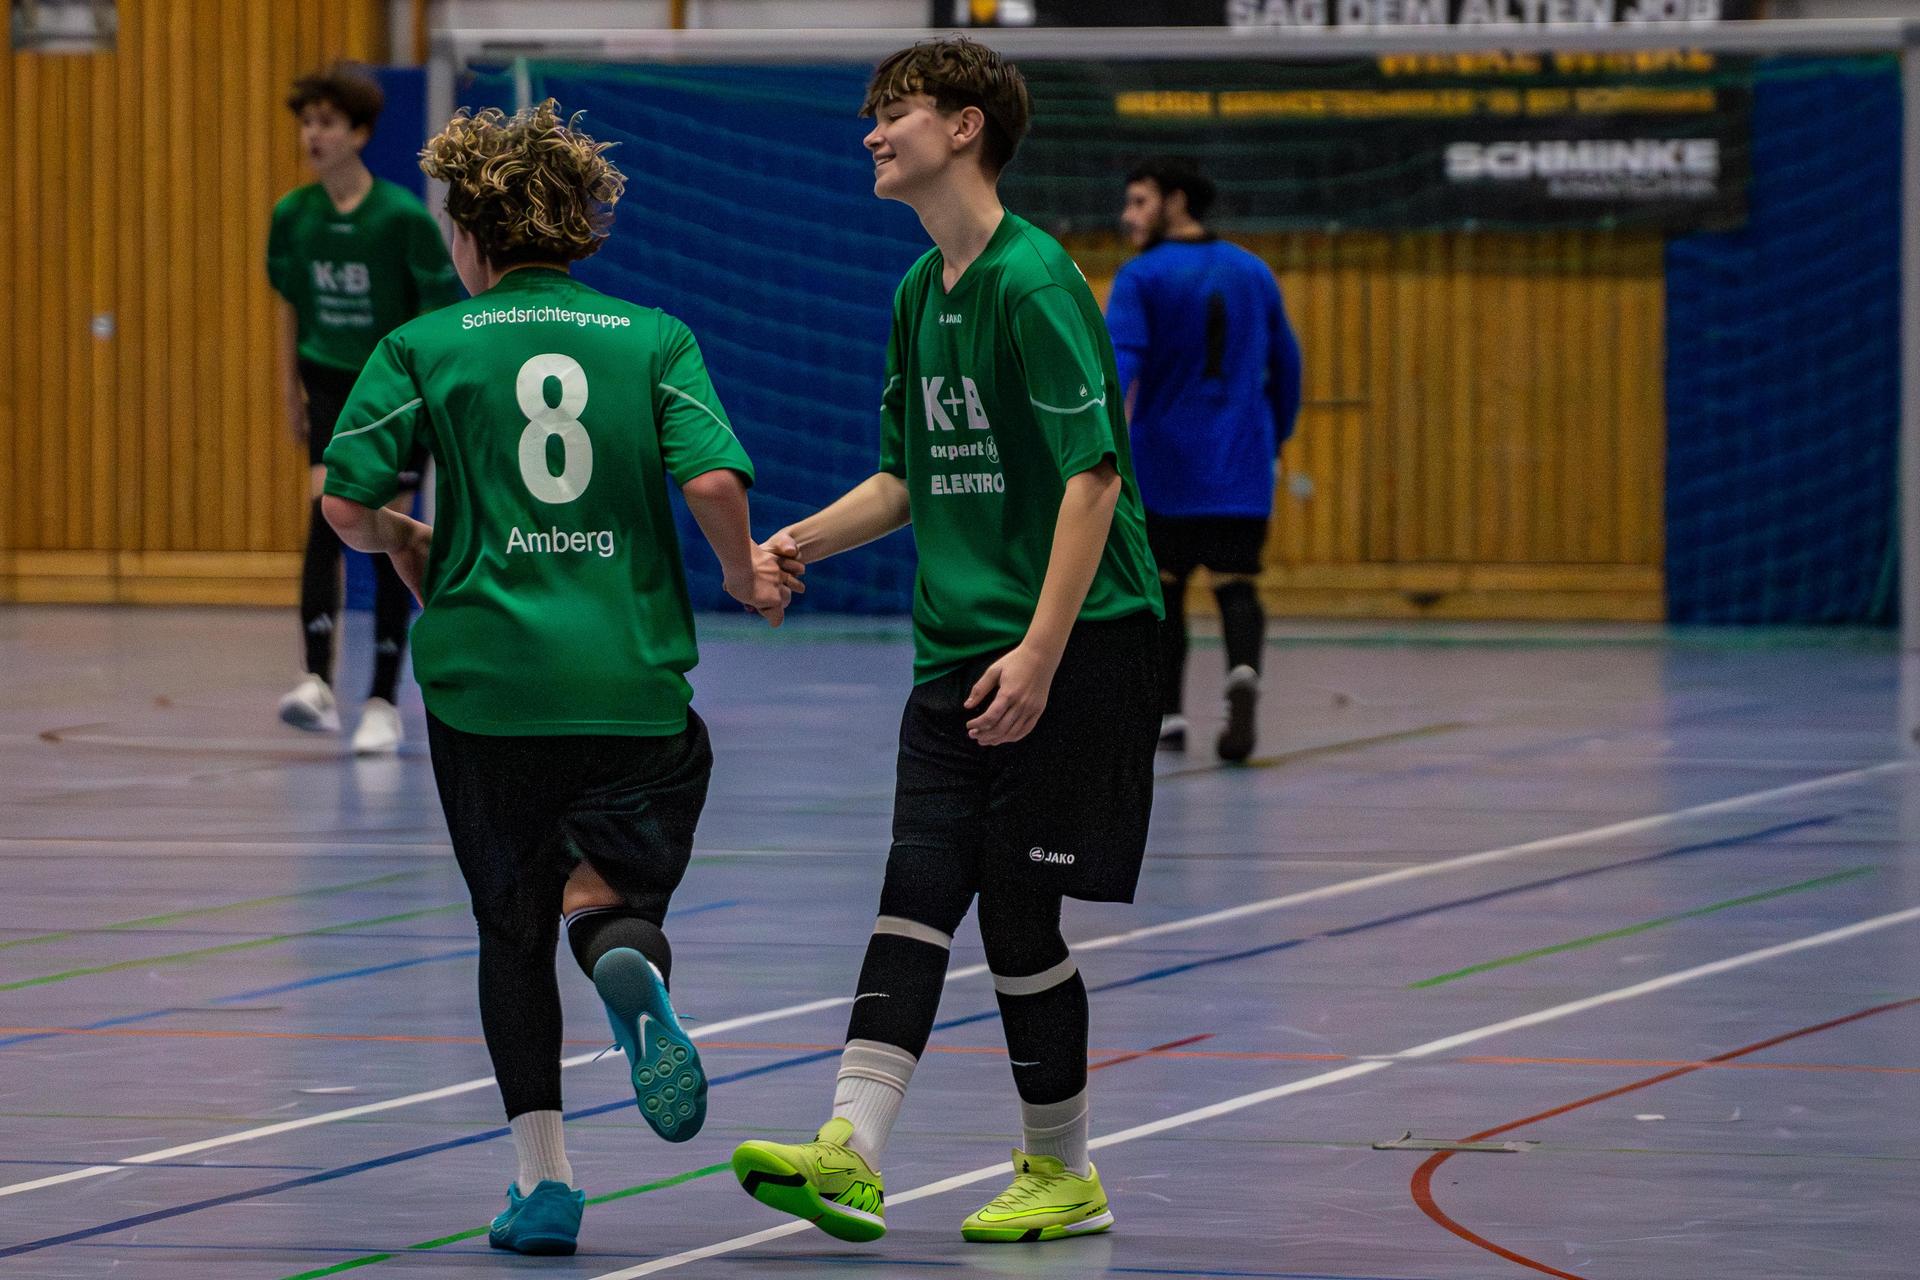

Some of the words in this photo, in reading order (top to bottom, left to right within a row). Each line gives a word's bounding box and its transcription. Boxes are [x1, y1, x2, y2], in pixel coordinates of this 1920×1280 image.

[1227, 0, 1328, 27] SAG
[1337, 0, 1448, 26] DEM
[1459, 0, 1615, 25] ALTEN
[1622, 0, 1720, 24] JOB
[1445, 139, 1719, 179] SCHMINKE
[462, 305, 631, 330] Schiedsrichtergruppe
[921, 375, 990, 431] K+B
[516, 353, 593, 504] 8
[930, 441, 985, 460] expert
[931, 472, 1005, 495] ELEKTRO
[506, 526, 615, 557] Amberg
[1045, 851, 1075, 864] JAKO
